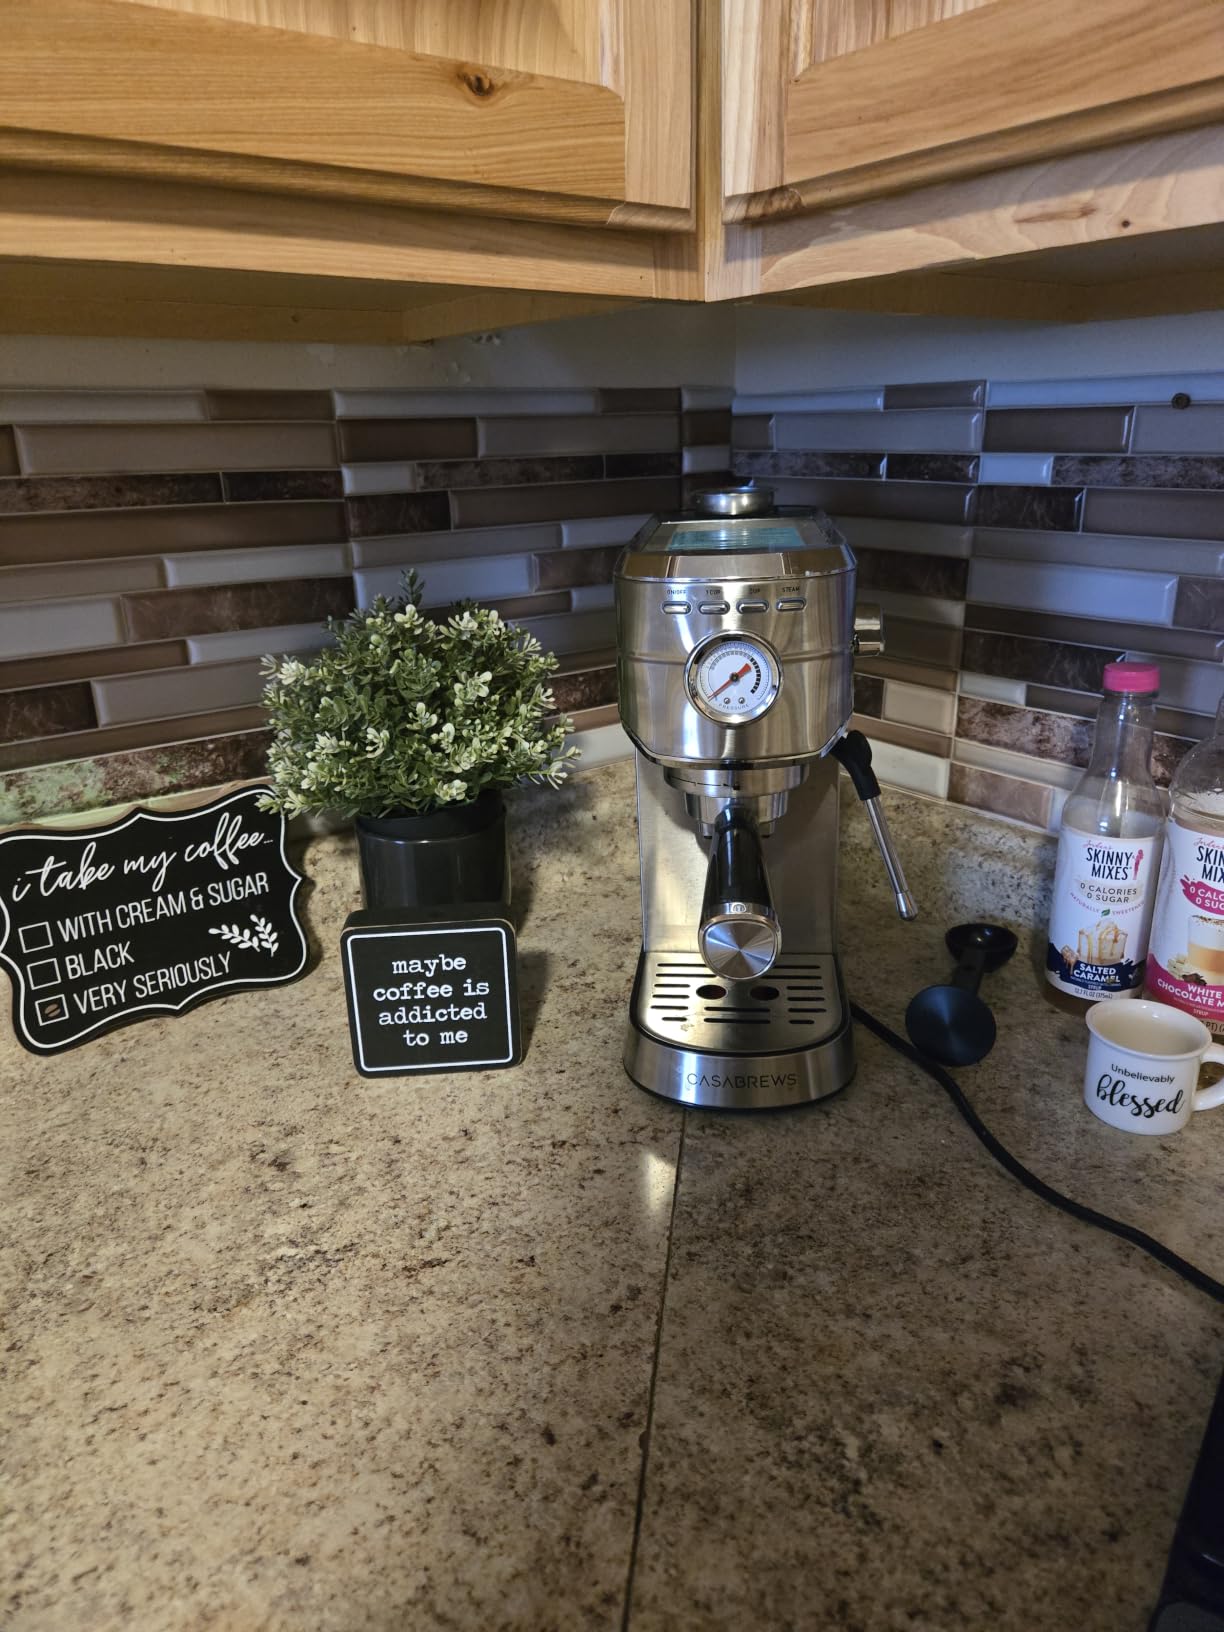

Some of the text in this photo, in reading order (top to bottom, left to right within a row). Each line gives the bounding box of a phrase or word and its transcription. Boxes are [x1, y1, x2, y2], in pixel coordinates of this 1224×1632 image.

[718, 703, 750, 711] PRESSURE
[1086, 847, 1133, 866] SKINNY
[12, 877, 31, 902] i
[25, 841, 116, 896] take
[123, 851, 177, 892] my
[1091, 863, 1129, 881] MIXES
[1080, 882, 1137, 896] 0 CALORIES
[1086, 892, 1130, 904] 0 SUGAR
[57, 872, 269, 943] WITH CREAM & SUGAR
[1195, 897, 1202, 905] 0
[65, 941, 135, 980] BLACK
[391, 954, 467, 977] maybe
[1079, 963, 1117, 975] SALTED
[73, 951, 231, 1014] VERY SERIOUSLY
[1073, 969, 1121, 983] CARAMEL
[372, 978, 490, 1001] coffee is
[1157, 978, 1215, 1006] CHOCOLATE
[1187, 984, 1222, 999] WHITE
[378, 1002, 487, 1025] addicted
[1193, 1008, 1209, 1016] SYRUP
[403, 1029, 468, 1046] to me
[686, 1072, 798, 1089] CASABREWS
[1111, 1063, 1175, 1084] Unbelievably
[1096, 1073, 1185, 1119] blessed
